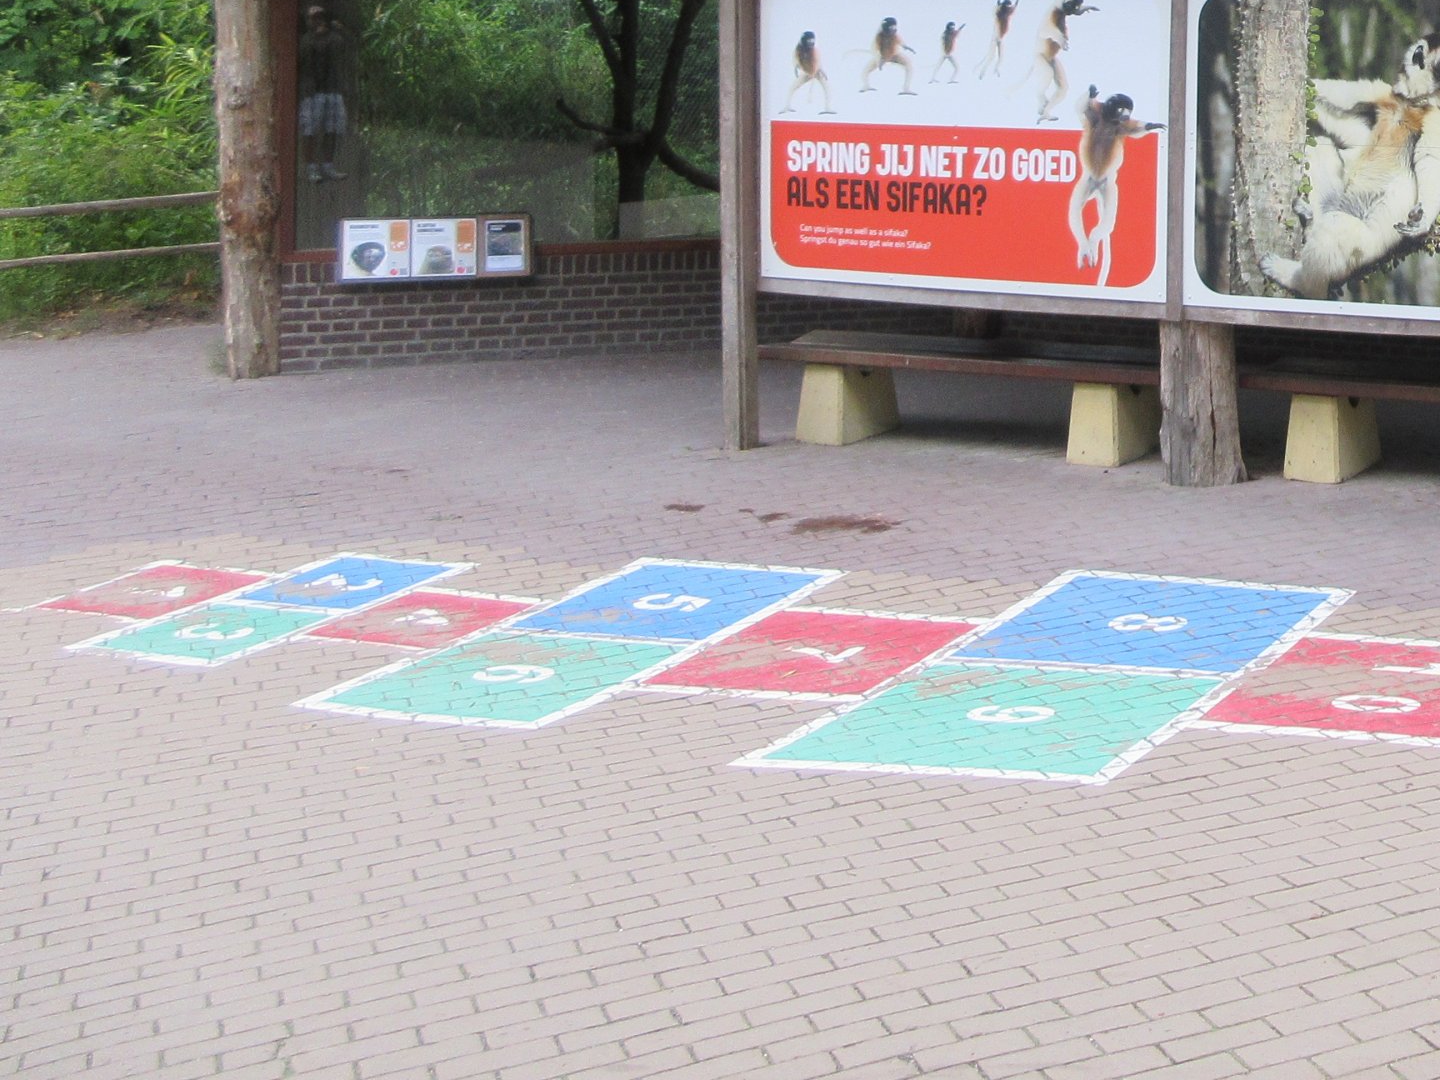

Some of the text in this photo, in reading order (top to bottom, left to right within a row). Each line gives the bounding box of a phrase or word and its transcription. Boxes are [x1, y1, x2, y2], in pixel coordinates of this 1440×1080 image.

[787, 140, 1077, 182] SPRING JIJ NET ZO GOED
[787, 176, 987, 217] ALS EEN SIFAKA?
[799, 223, 812, 232] Can
[813, 225, 826, 234] you
[826, 226, 844, 236] jump
[853, 227, 868, 236] well
[883, 228, 908, 238] sifaka?
[828, 236, 837, 245] du
[868, 239, 880, 249] gut
[906, 239, 931, 250] Sifaka?
[303, 573, 384, 591] 2
[631, 592, 712, 612] 5
[174, 622, 255, 640] 3
[1107, 613, 1189, 633] 8
[784, 646, 866, 663] 7
[472, 664, 556, 684] 6
[965, 704, 1056, 723] 9
